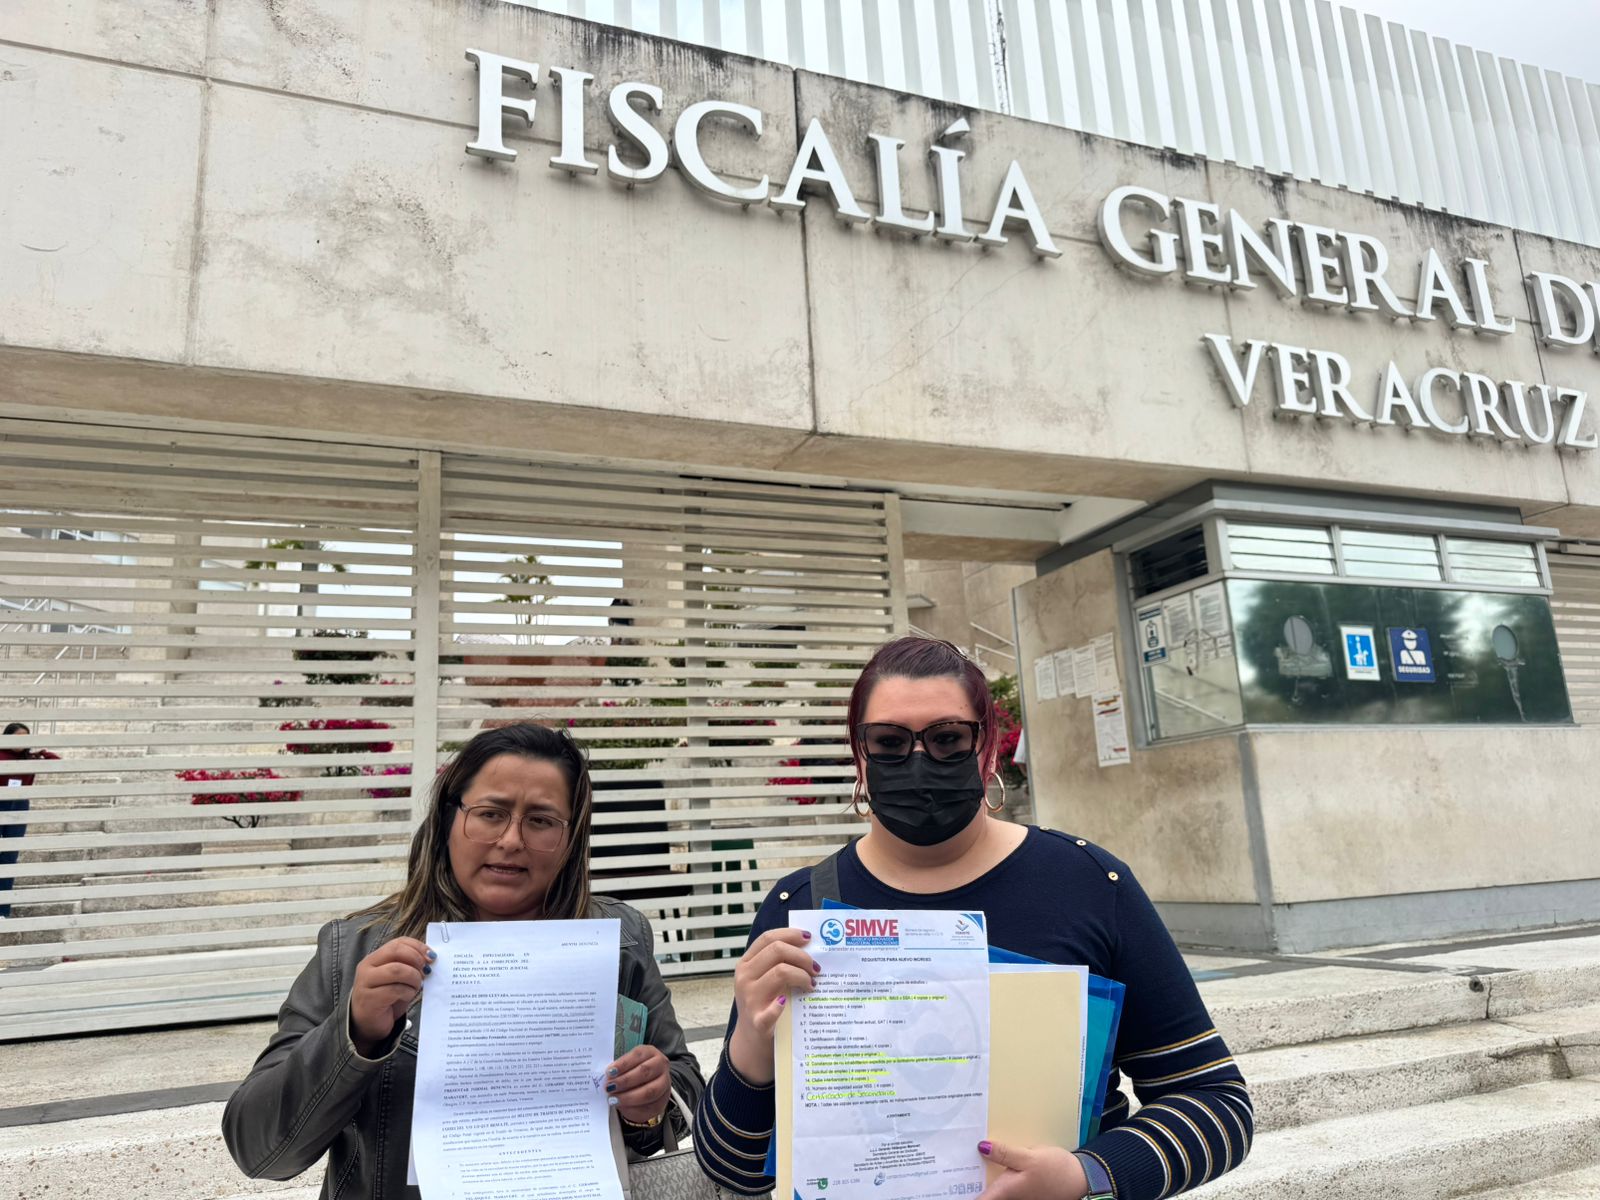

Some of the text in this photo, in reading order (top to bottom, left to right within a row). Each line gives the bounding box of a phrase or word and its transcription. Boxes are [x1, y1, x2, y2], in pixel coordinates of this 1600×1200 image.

[465, 48, 1063, 259] FISCALÍA
[1101, 185, 1516, 336] GENERAL
[1202, 333, 1598, 451] VERACRUZ
[845, 918, 899, 937] SIMVE
